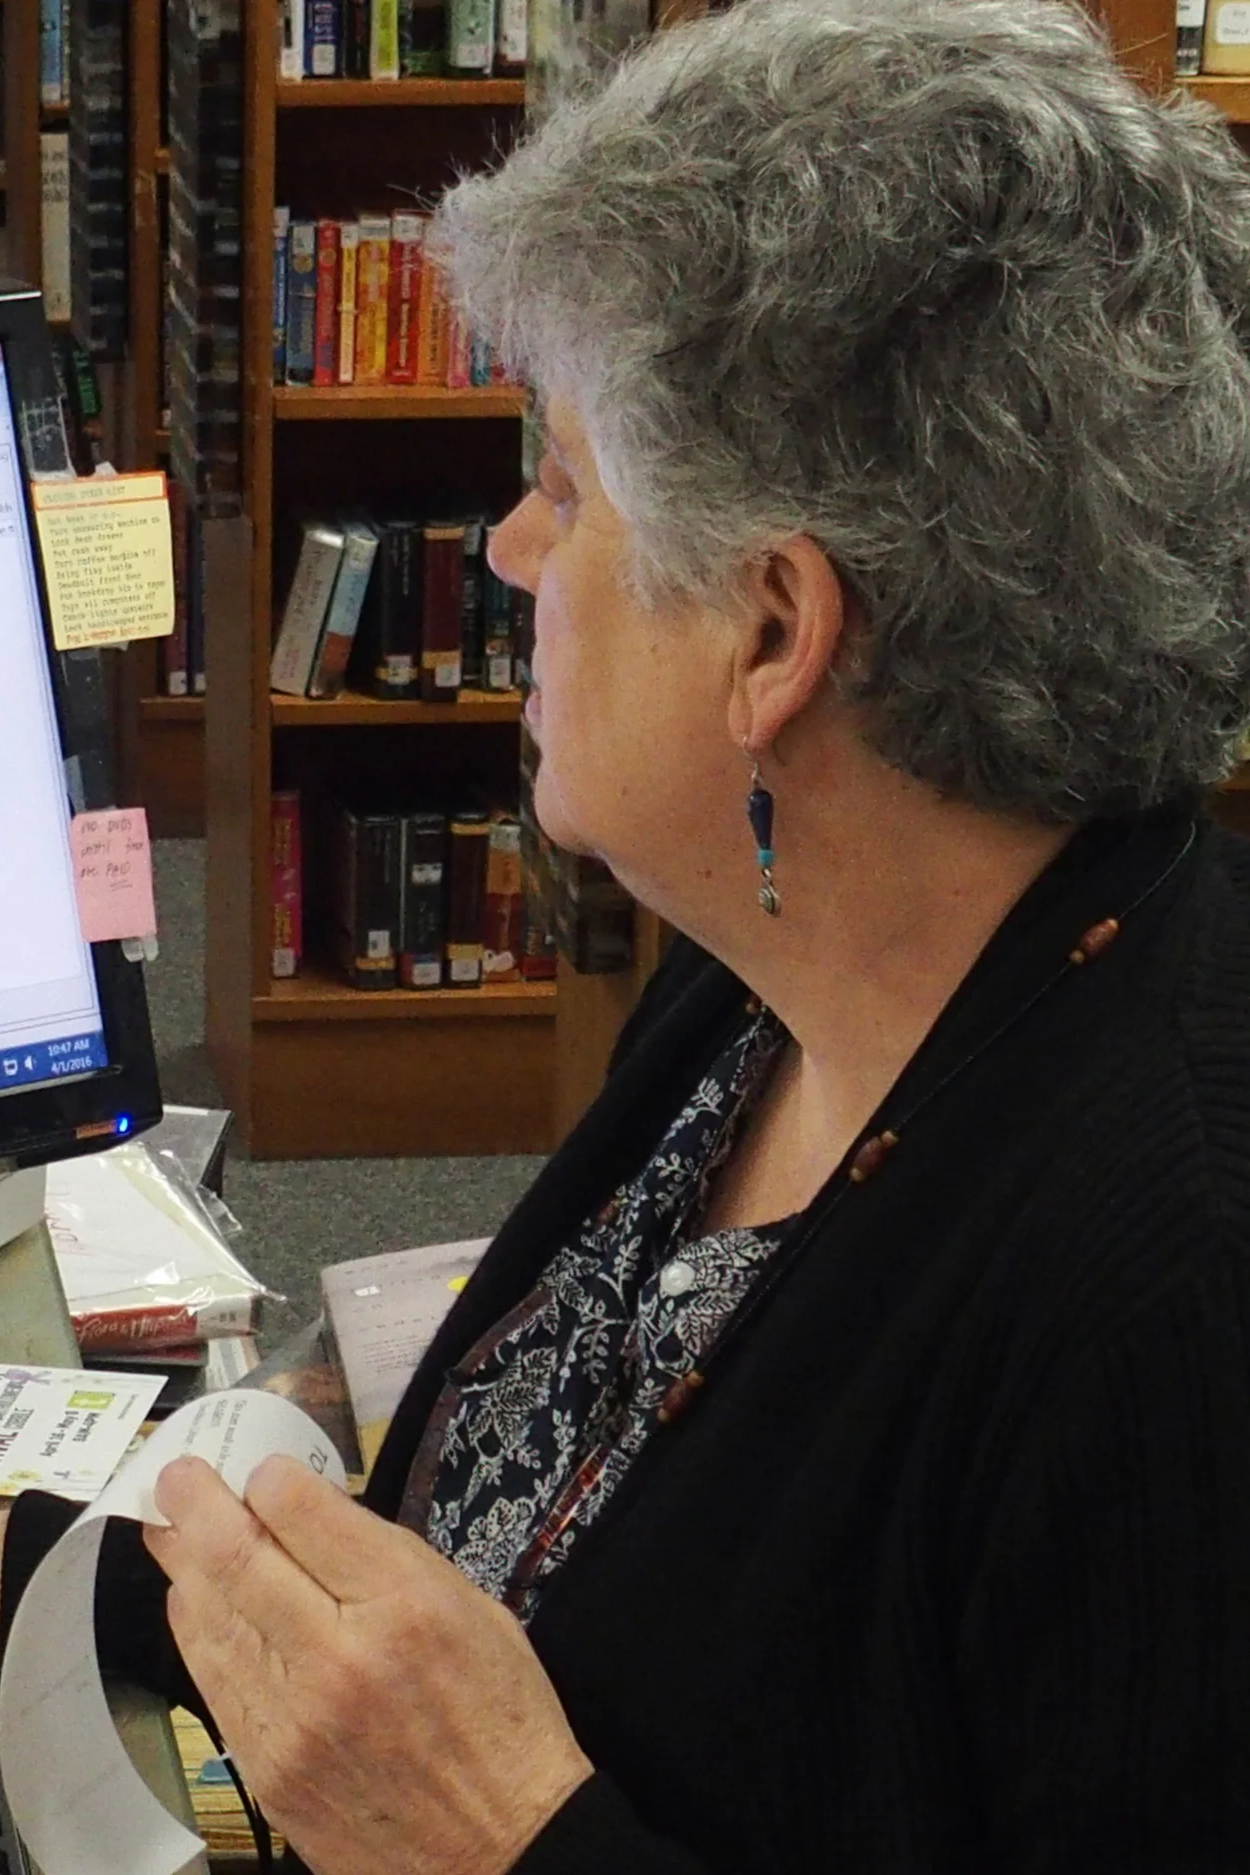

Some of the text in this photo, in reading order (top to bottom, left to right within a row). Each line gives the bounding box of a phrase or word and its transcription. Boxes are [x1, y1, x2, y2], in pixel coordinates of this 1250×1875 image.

[48, 1038, 91, 1057] 10:47 AM
[51, 1057, 94, 1075] 4/1/2016
